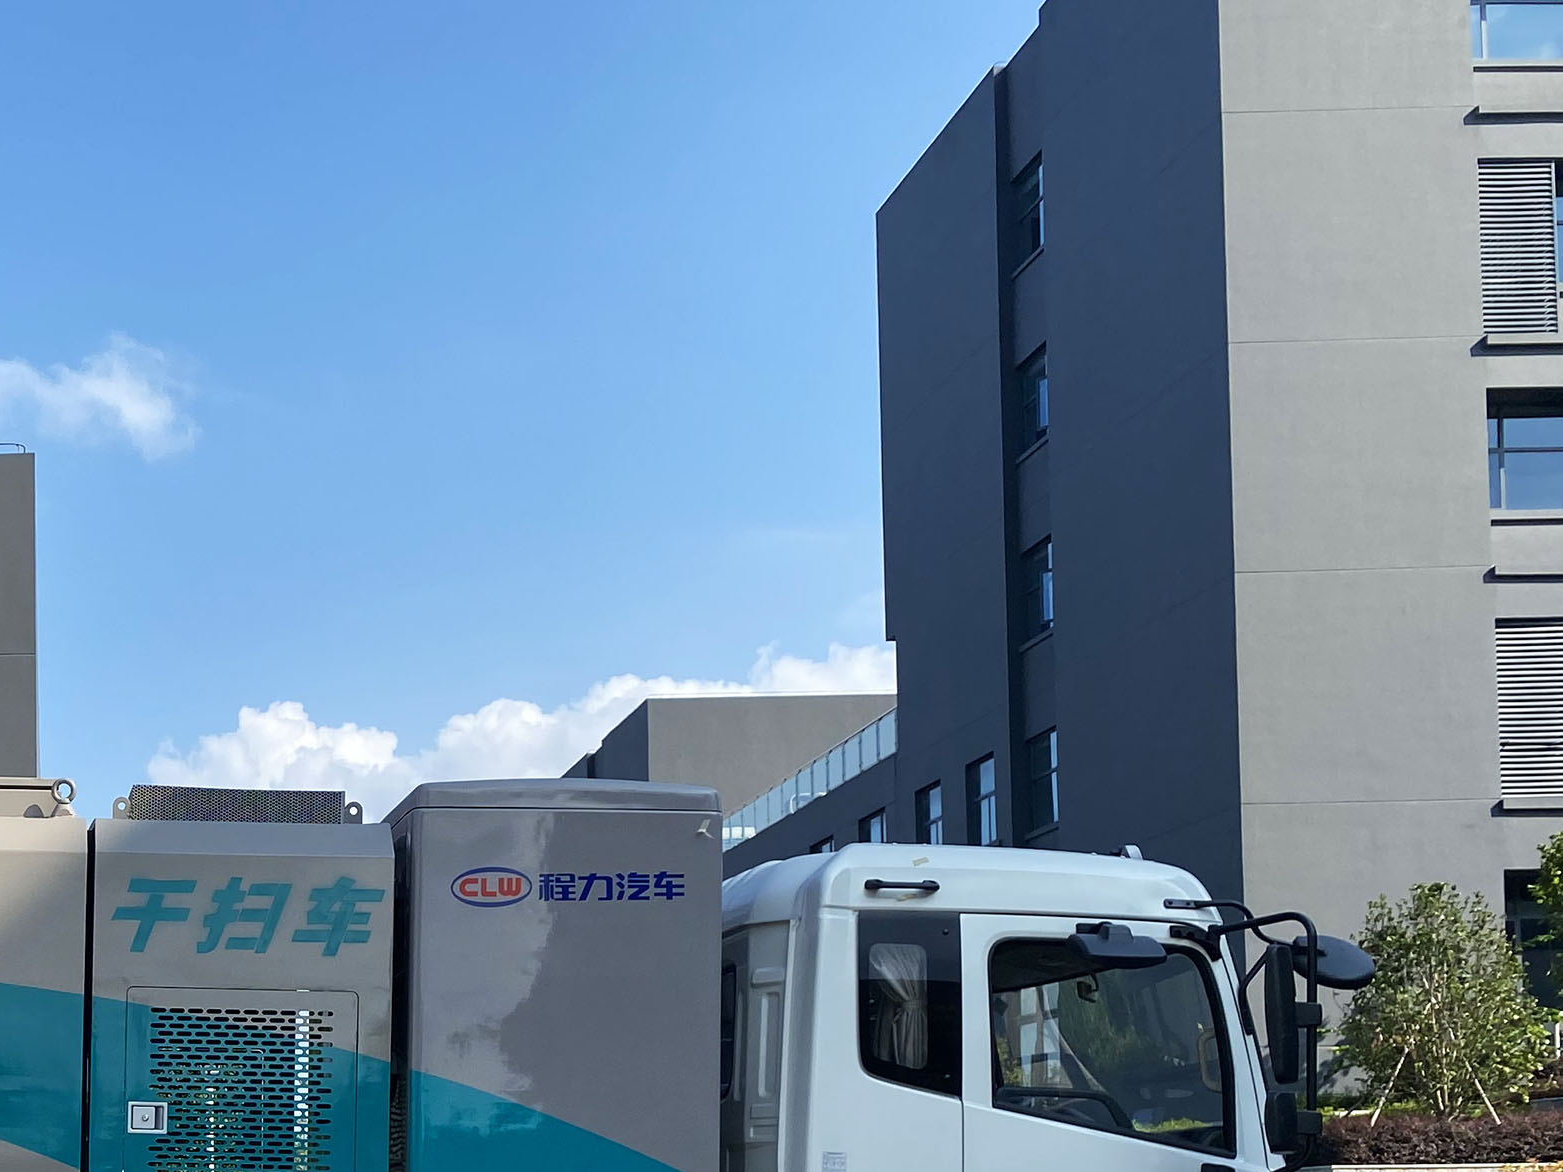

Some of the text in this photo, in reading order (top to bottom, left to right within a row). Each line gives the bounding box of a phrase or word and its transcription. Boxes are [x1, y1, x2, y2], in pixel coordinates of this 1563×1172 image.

[459, 871, 685, 902] CLW 程力汽车
[110, 876, 386, 957] 干扫车
